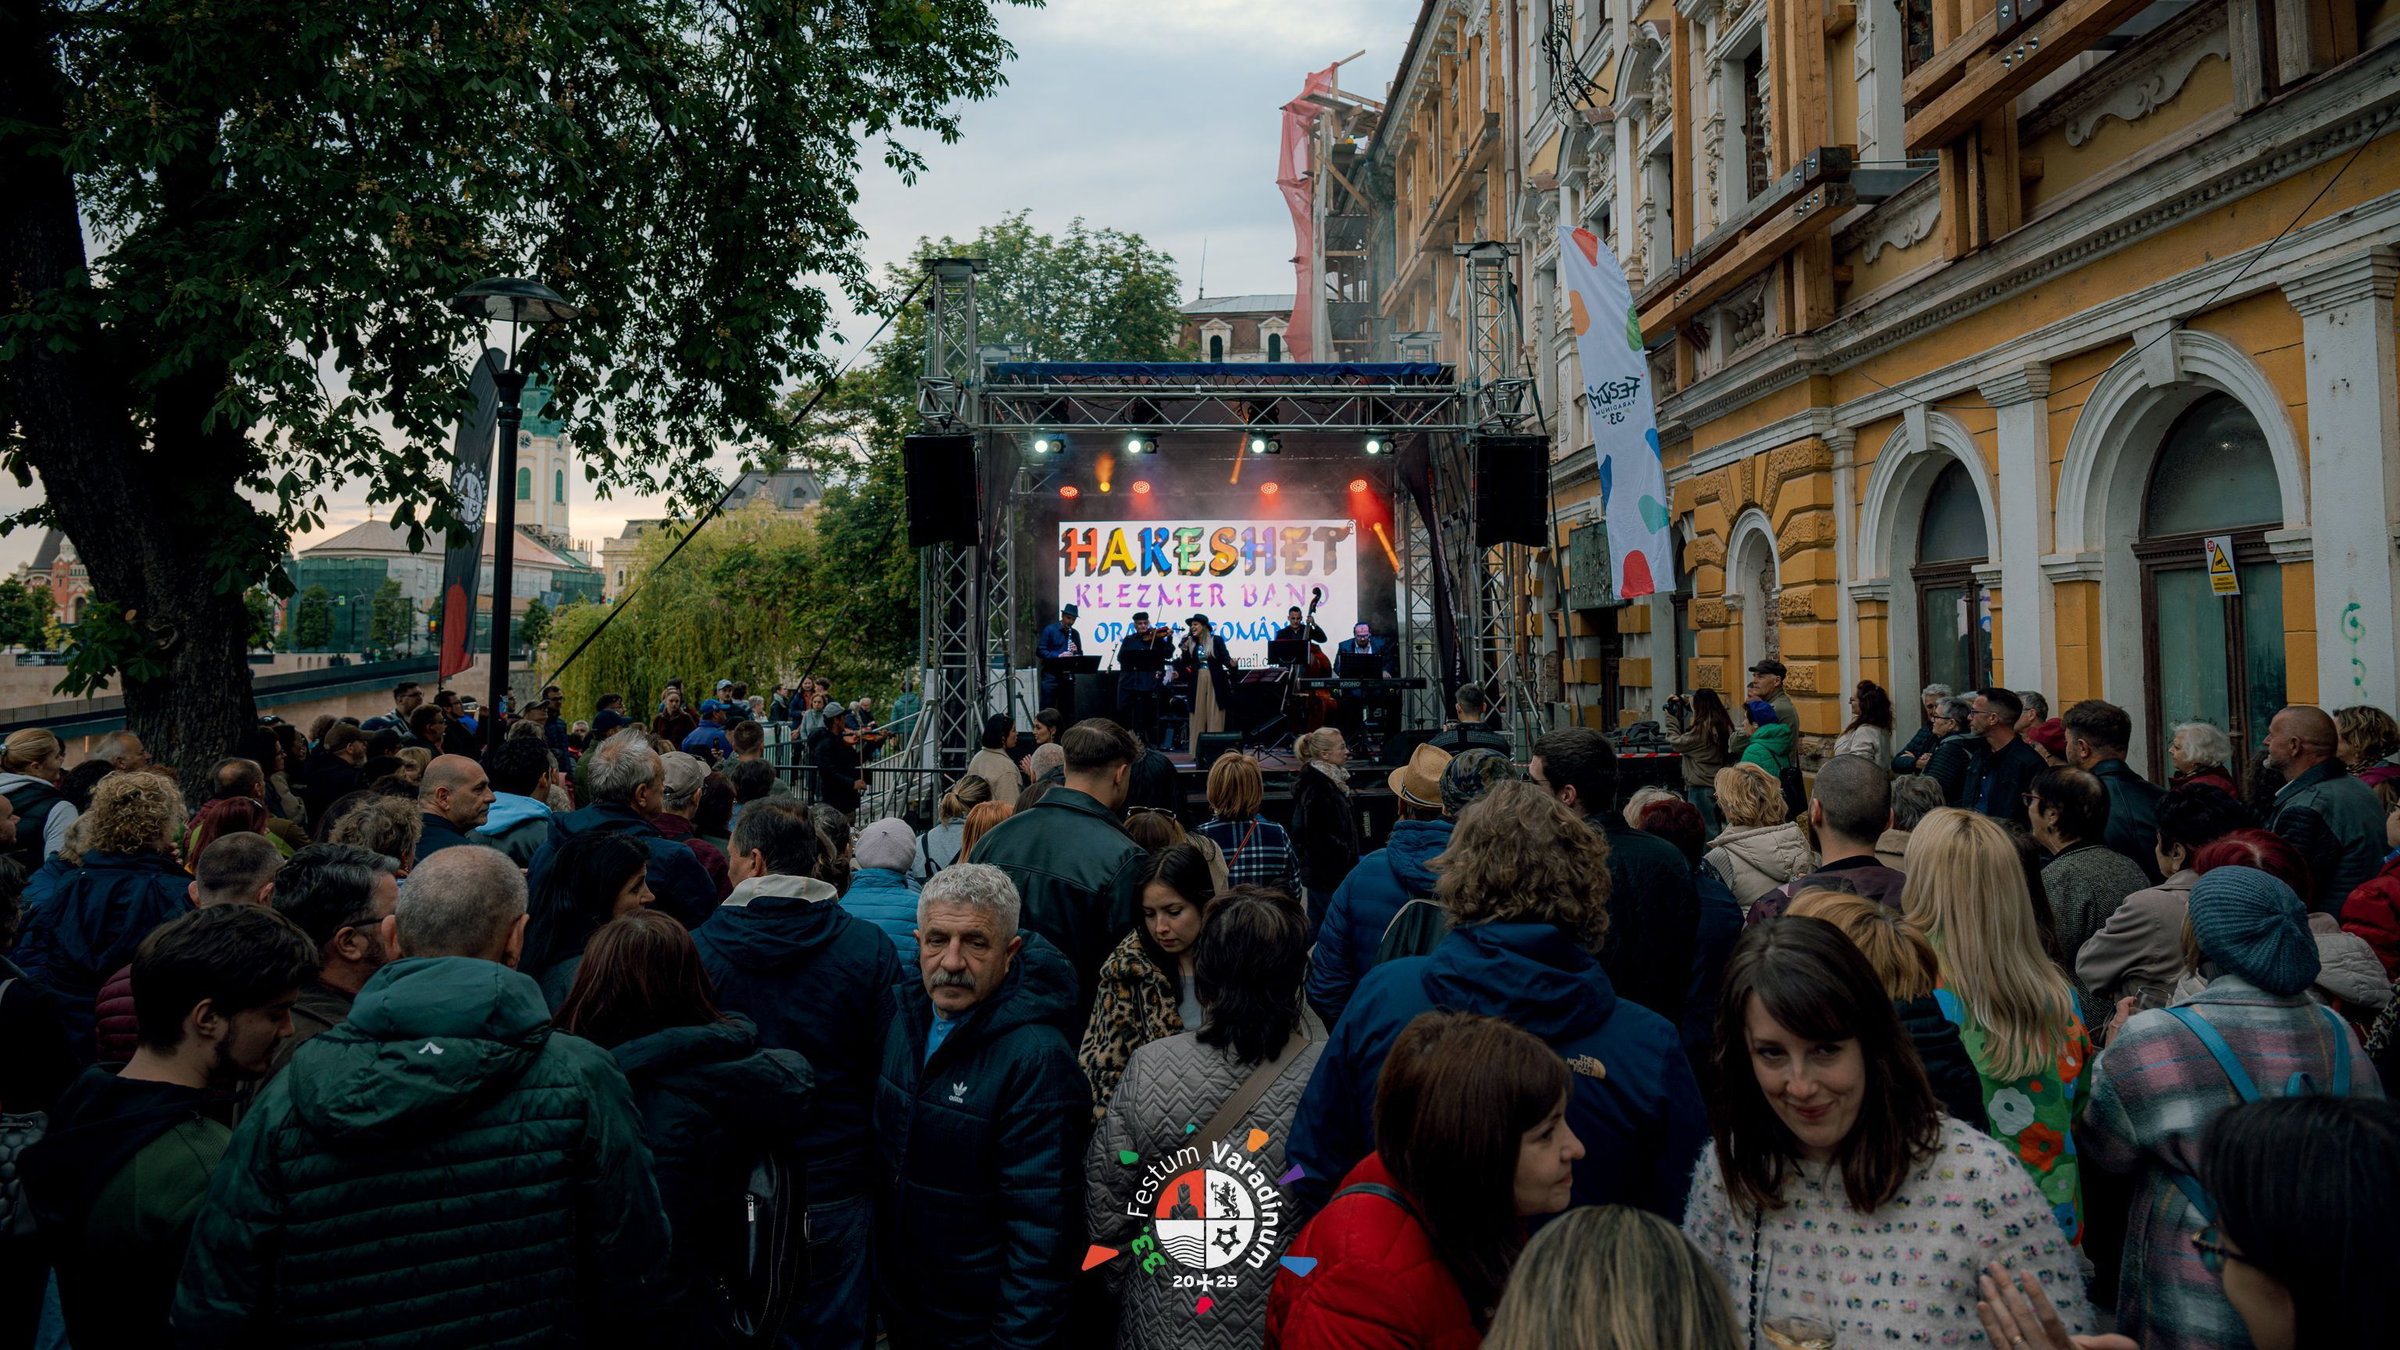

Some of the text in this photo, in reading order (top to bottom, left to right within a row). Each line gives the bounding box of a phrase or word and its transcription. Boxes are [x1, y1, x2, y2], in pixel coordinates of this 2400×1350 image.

[1060, 527, 1353, 577] HAKESHET
[1075, 583, 1330, 608] KLEZMER BAND
